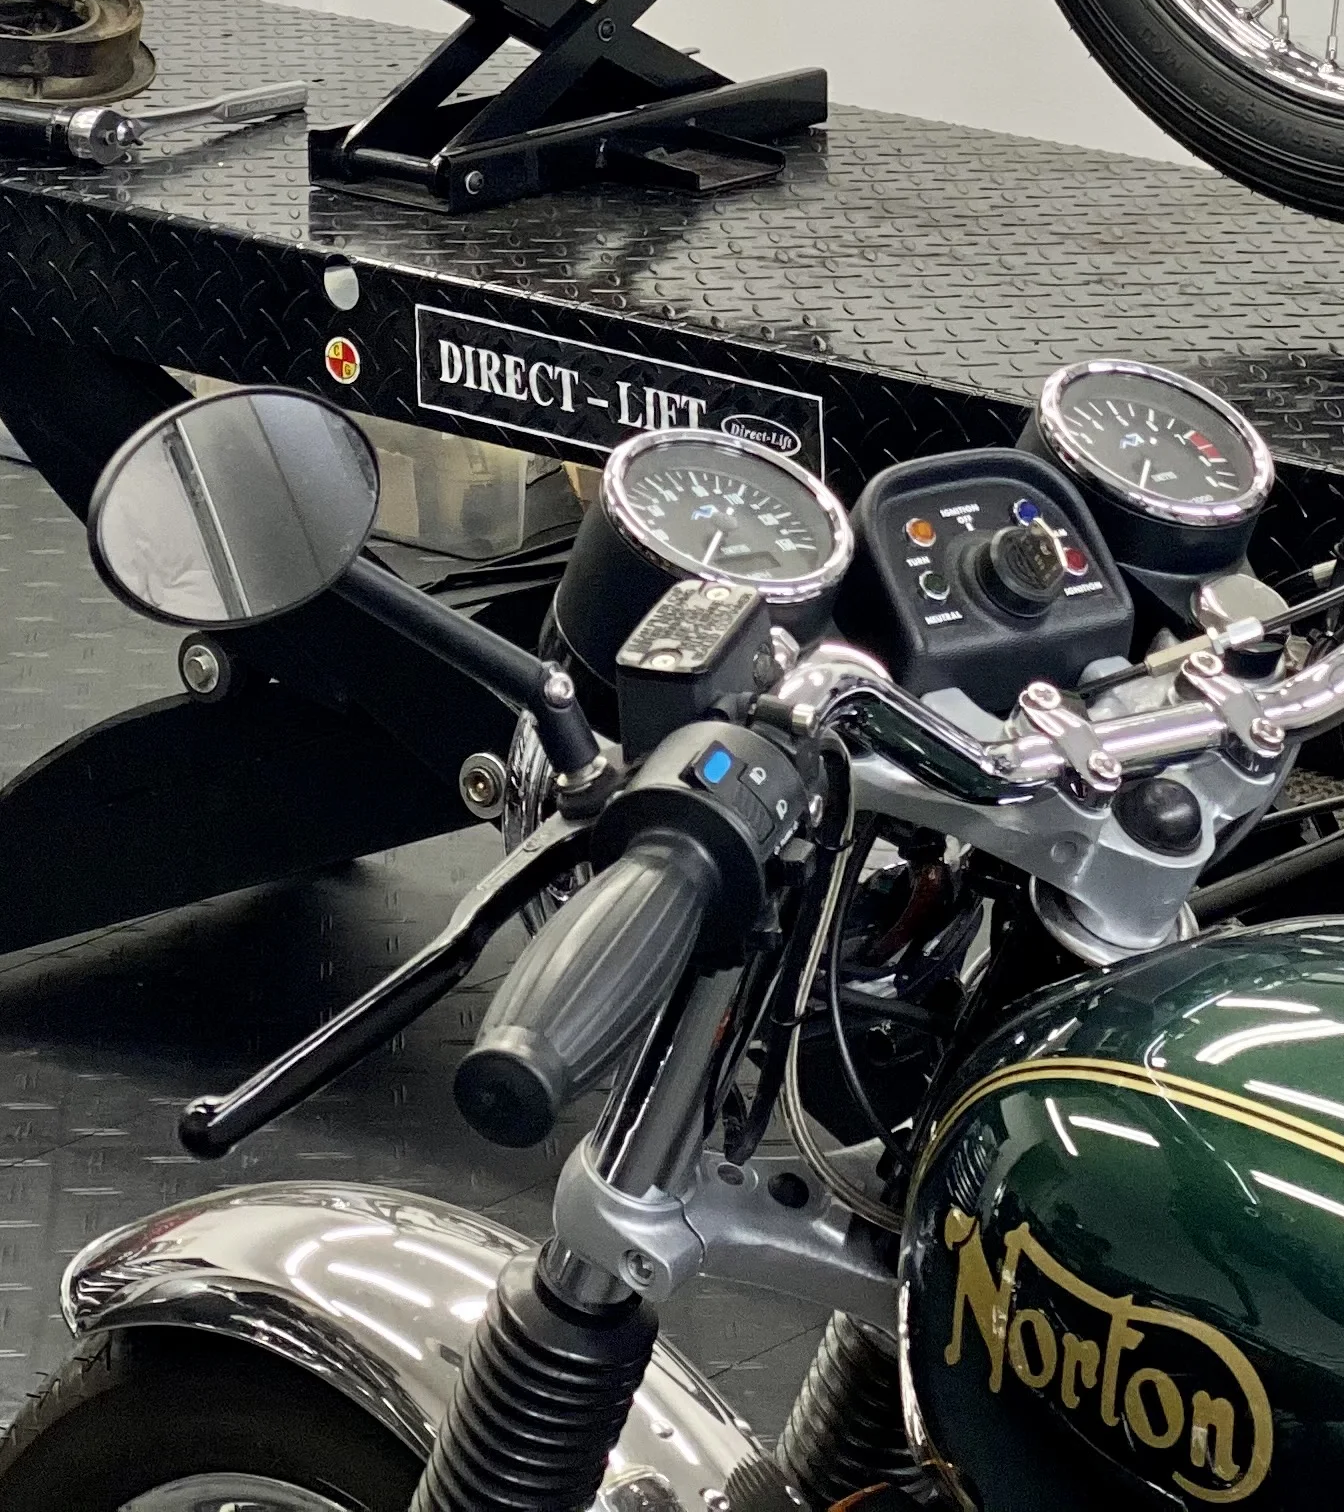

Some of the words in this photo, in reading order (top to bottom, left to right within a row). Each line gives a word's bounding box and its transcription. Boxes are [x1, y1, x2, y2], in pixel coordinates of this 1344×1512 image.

[333, 344, 340, 357] C
[344, 364, 352, 376] G
[438, 338, 580, 414] DIRECT
[615, 380, 707, 431] LIFT
[730, 422, 793, 450] Direct-Lift
[939, 503, 980, 518] IGNITION
[906, 556, 931, 568] TURN
[1063, 582, 1104, 596] IGNITION
[943, 1202, 1274, 1504] Norton
